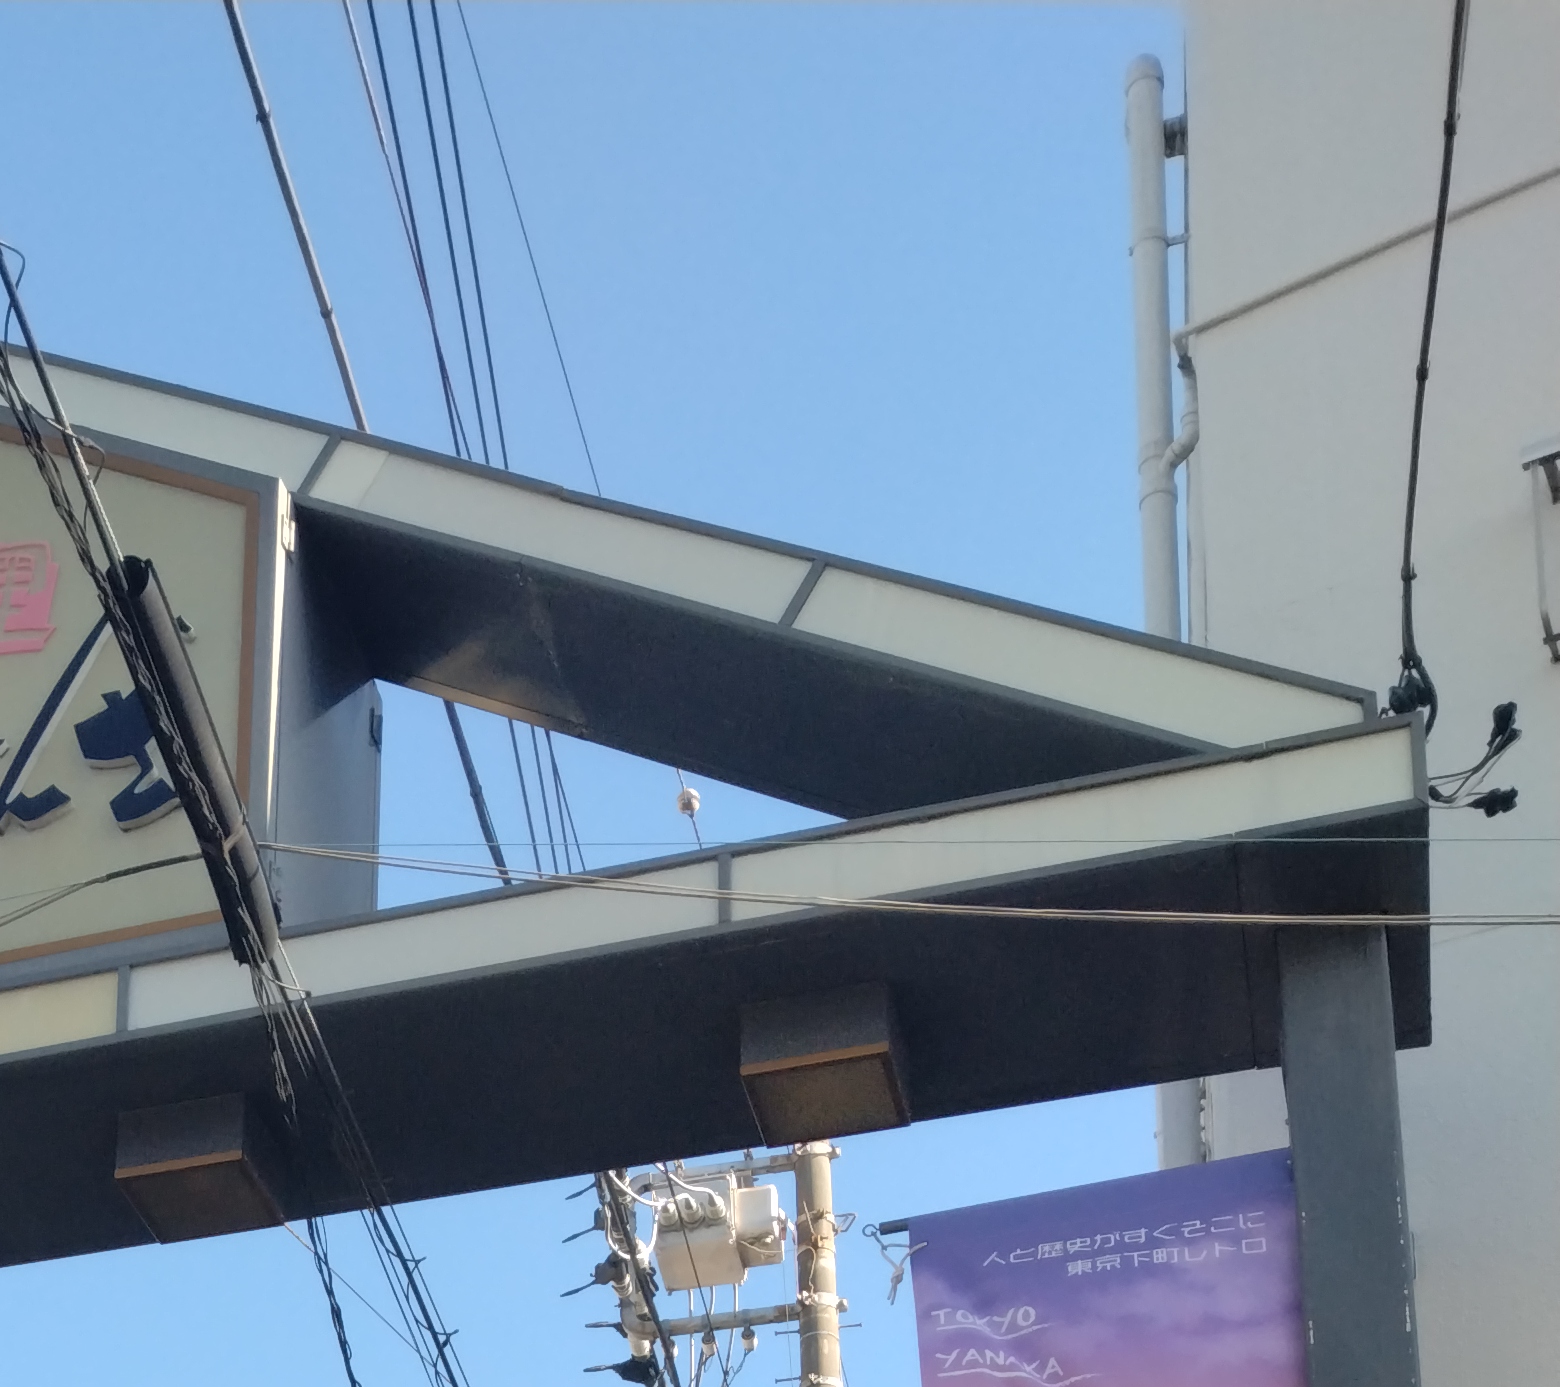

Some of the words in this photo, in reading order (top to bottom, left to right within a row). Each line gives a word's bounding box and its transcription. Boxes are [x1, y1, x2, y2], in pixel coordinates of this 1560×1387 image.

[1067, 1237, 1268, 1276] 東京下町レトロ
[931, 1305, 1037, 1331] TOKYO
[935, 1347, 1064, 1380] YANAKA
